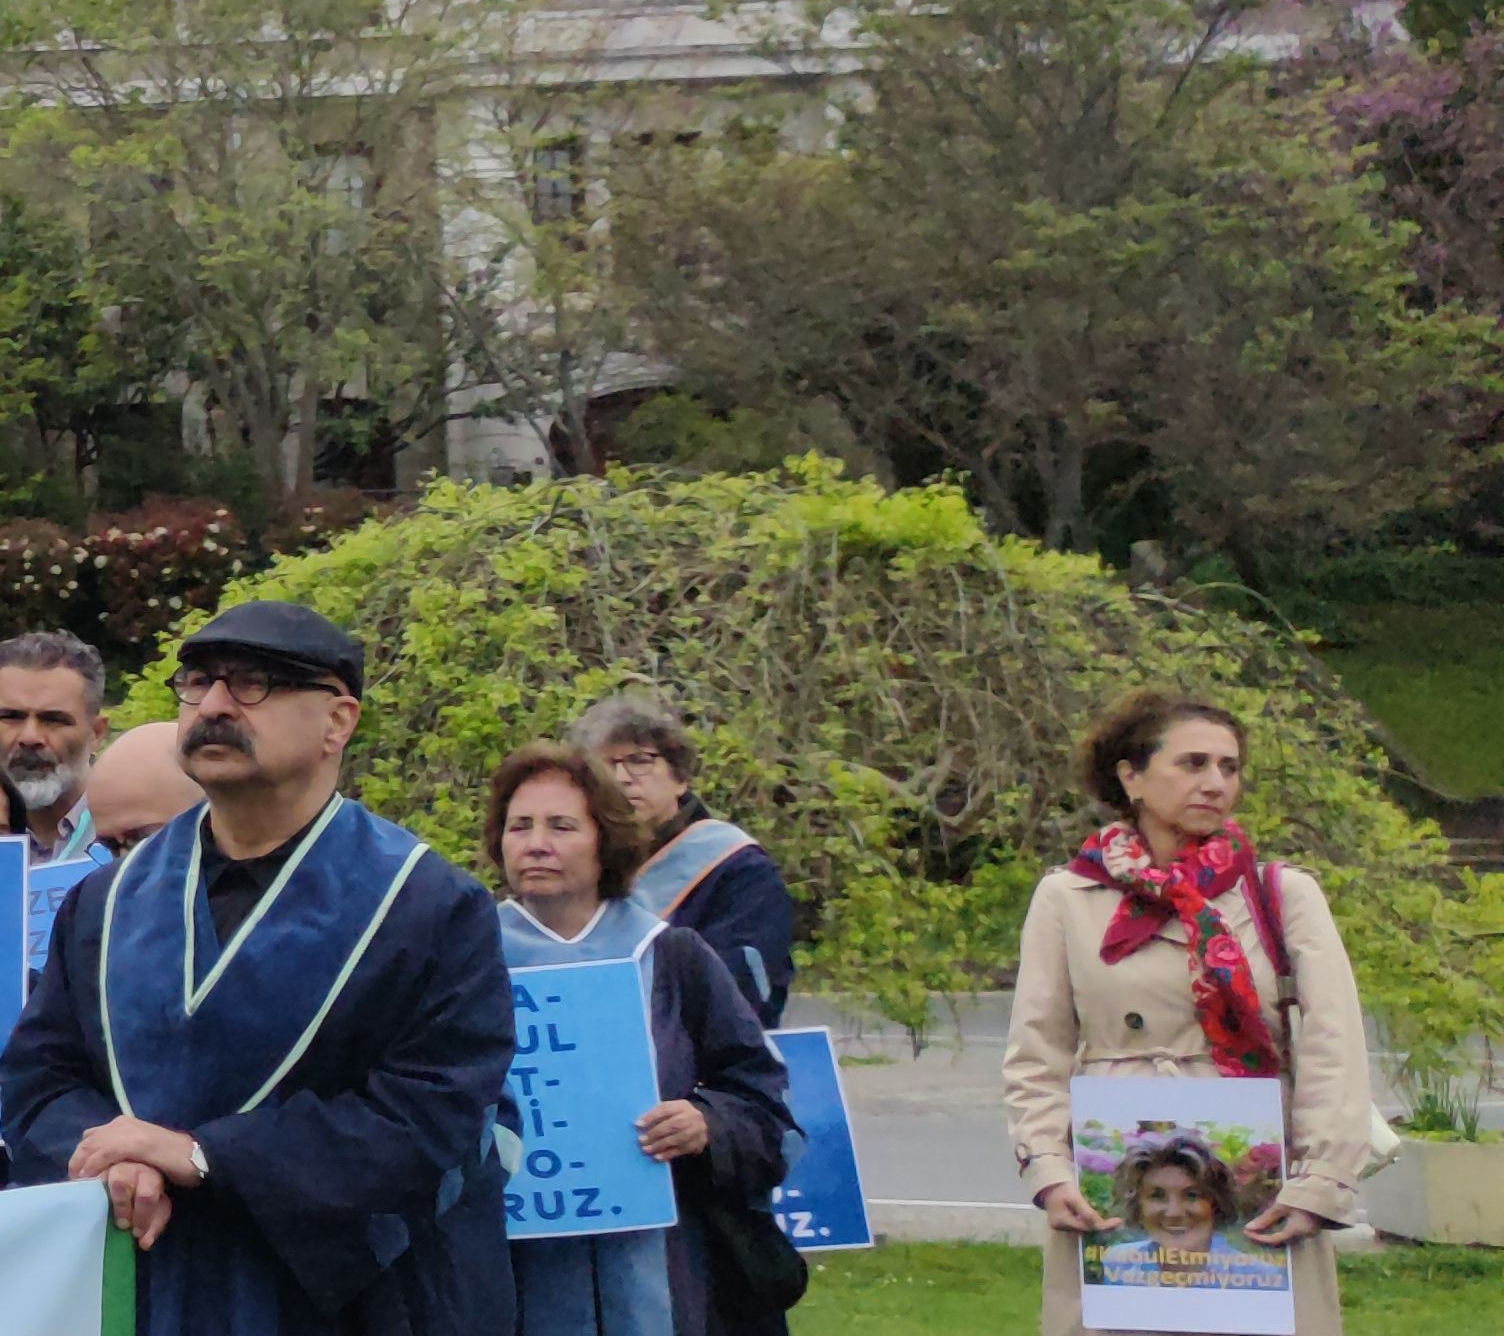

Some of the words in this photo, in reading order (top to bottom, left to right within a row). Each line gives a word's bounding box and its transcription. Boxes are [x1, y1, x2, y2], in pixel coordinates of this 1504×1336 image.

[511, 983, 561, 1013] A-
[513, 1022, 577, 1056] UL
[510, 1066, 561, 1098] T-
[527, 1098, 569, 1138] İ-
[525, 1148, 586, 1179] O-
[503, 1187, 624, 1222] RUZ.
